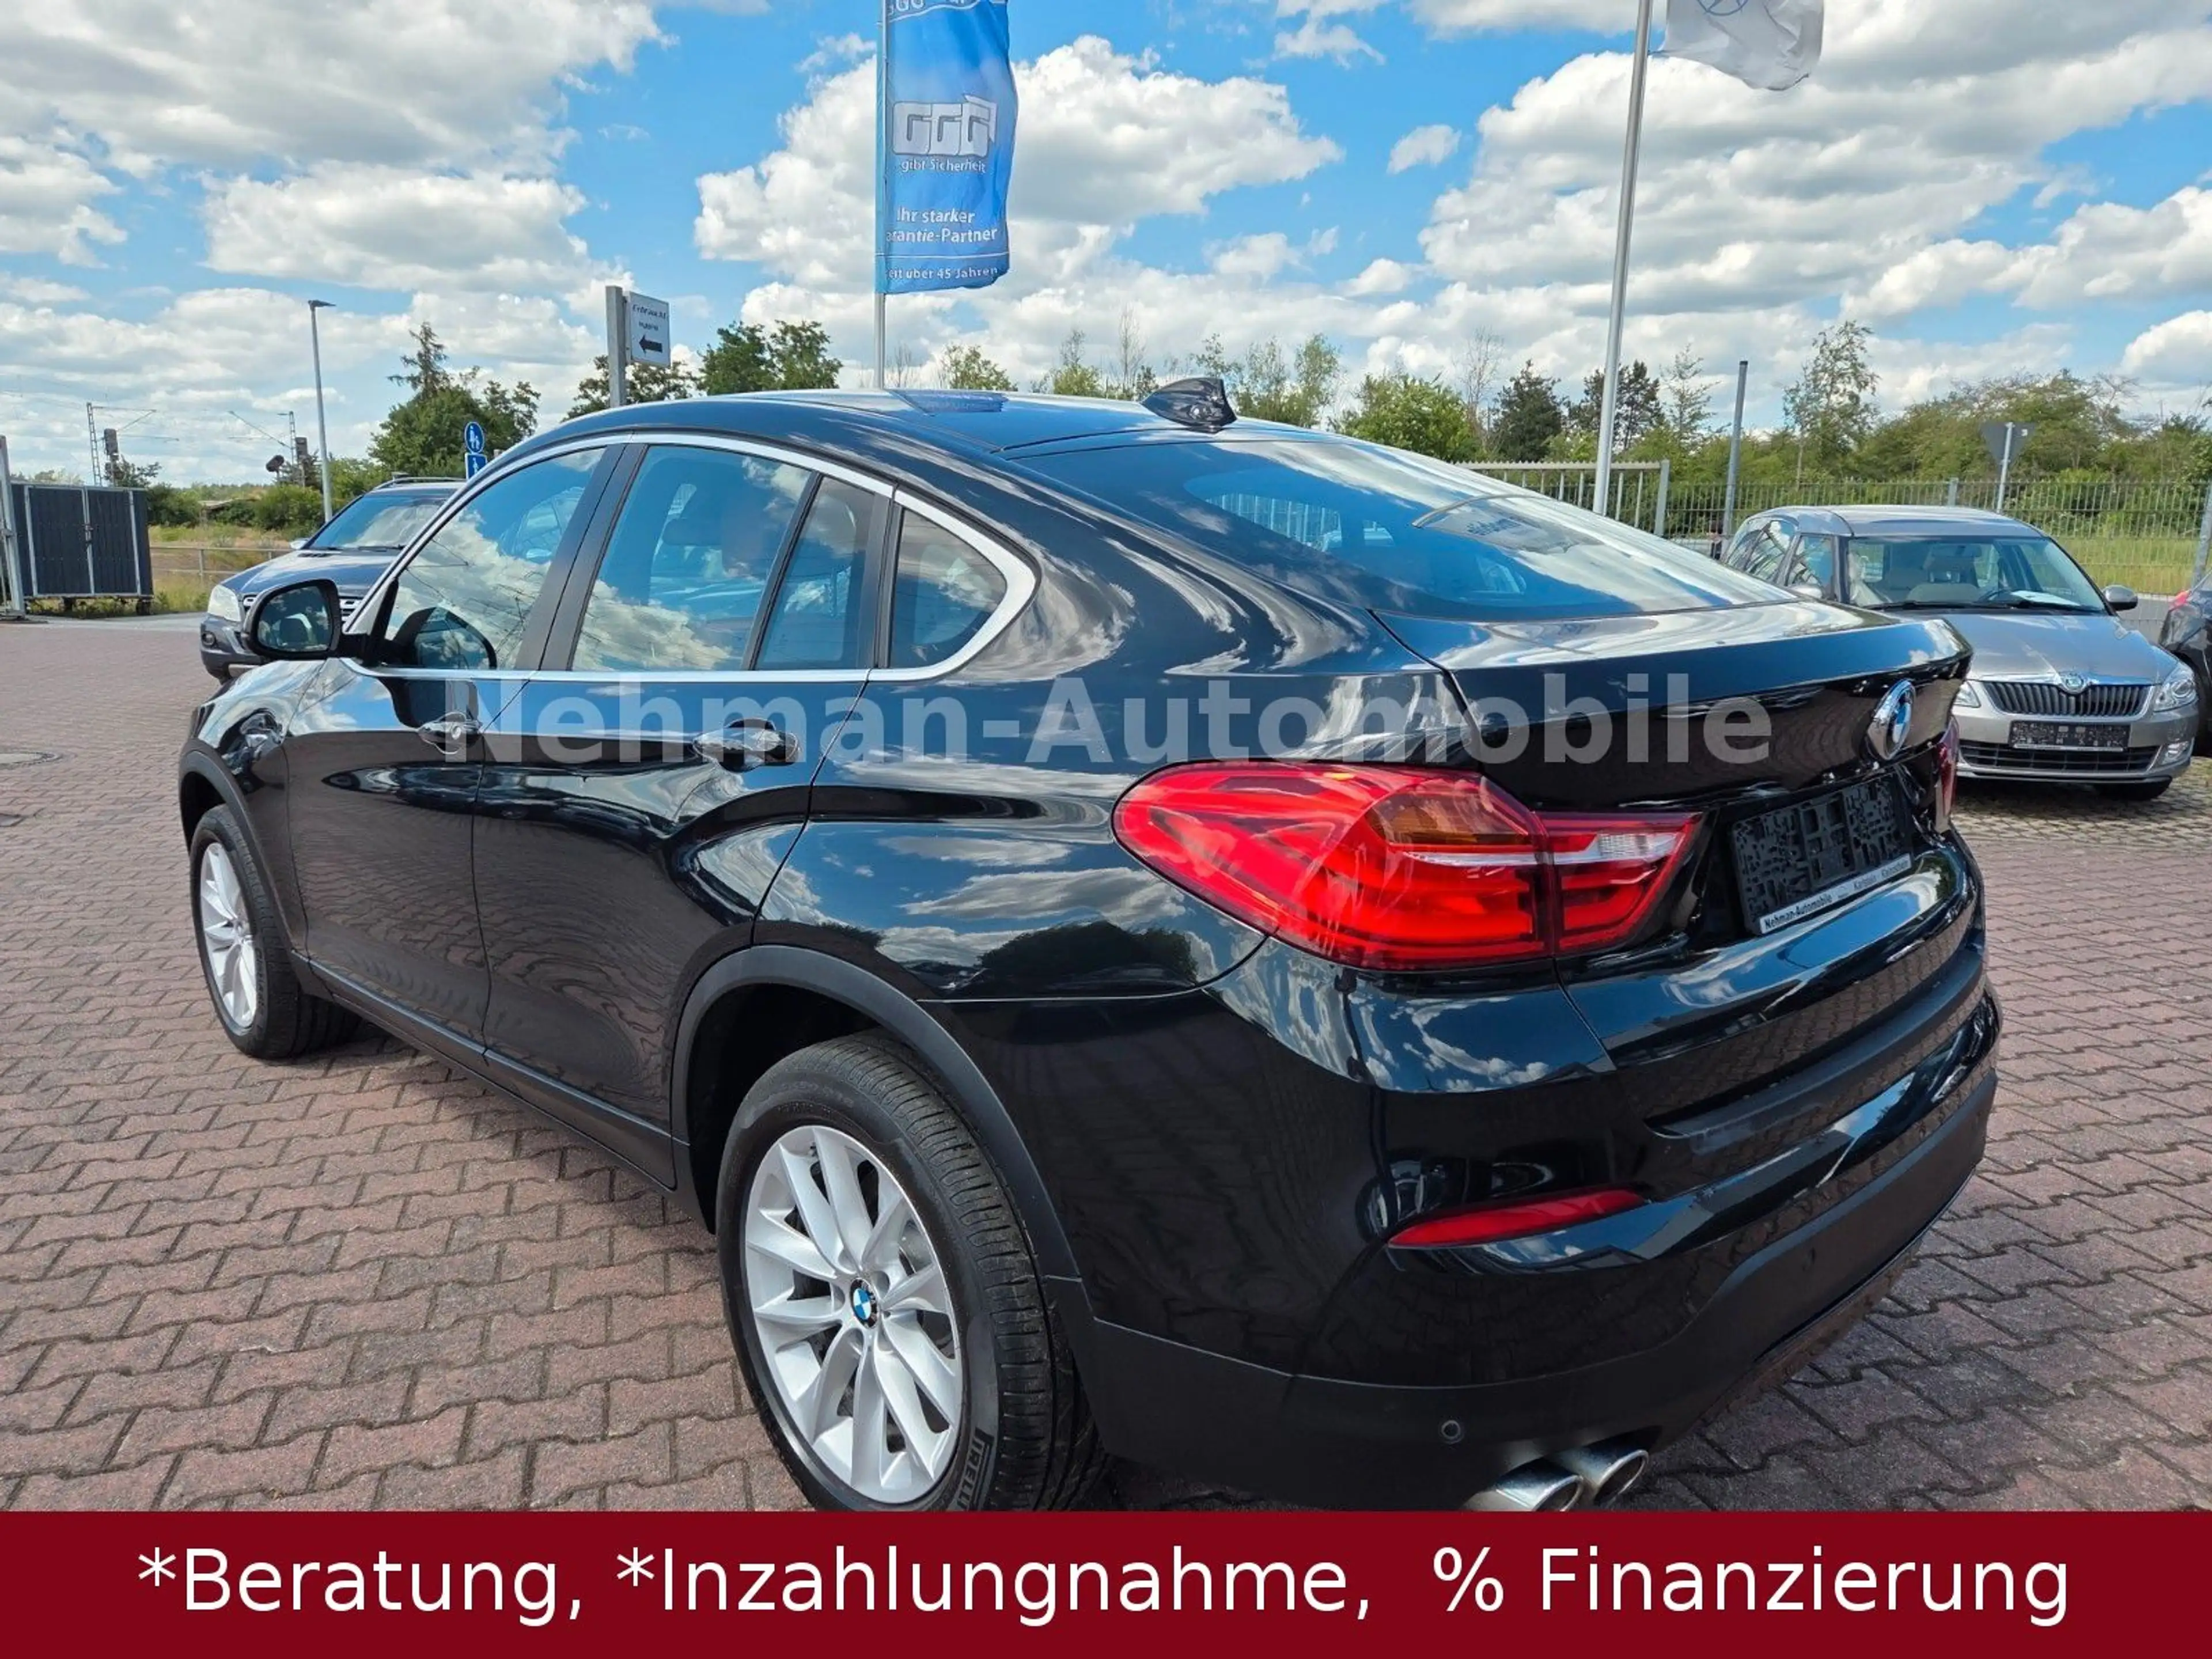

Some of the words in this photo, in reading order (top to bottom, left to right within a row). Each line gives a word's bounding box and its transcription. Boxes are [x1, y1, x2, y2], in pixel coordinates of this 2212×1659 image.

[929, 158, 986, 173] Sicherheit
[897, 206, 916, 222] Ihr
[922, 207, 975, 224] starker
[886, 228, 998, 243] arantie-Partner
[888, 267, 903, 279] eit
[937, 268, 952, 279] 45
[955, 266, 998, 279] Jahren
